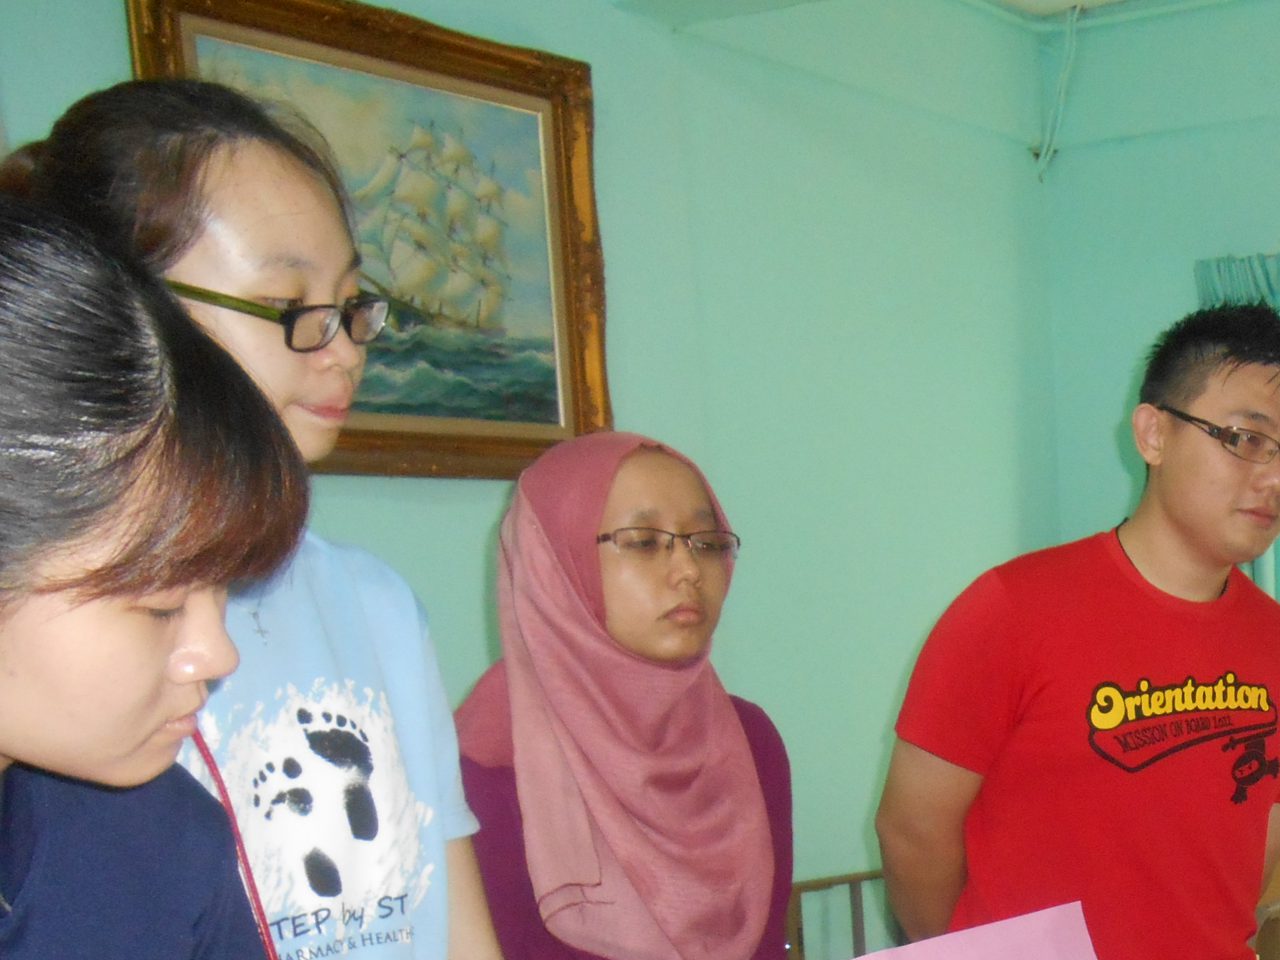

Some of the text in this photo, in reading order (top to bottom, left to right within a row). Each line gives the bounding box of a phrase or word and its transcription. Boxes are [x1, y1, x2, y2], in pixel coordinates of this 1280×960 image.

[1089, 672, 1270, 730] Orientation
[1114, 723, 1168, 753] MISSION
[269, 907, 332, 941] TEP
[342, 902, 365, 929] by
